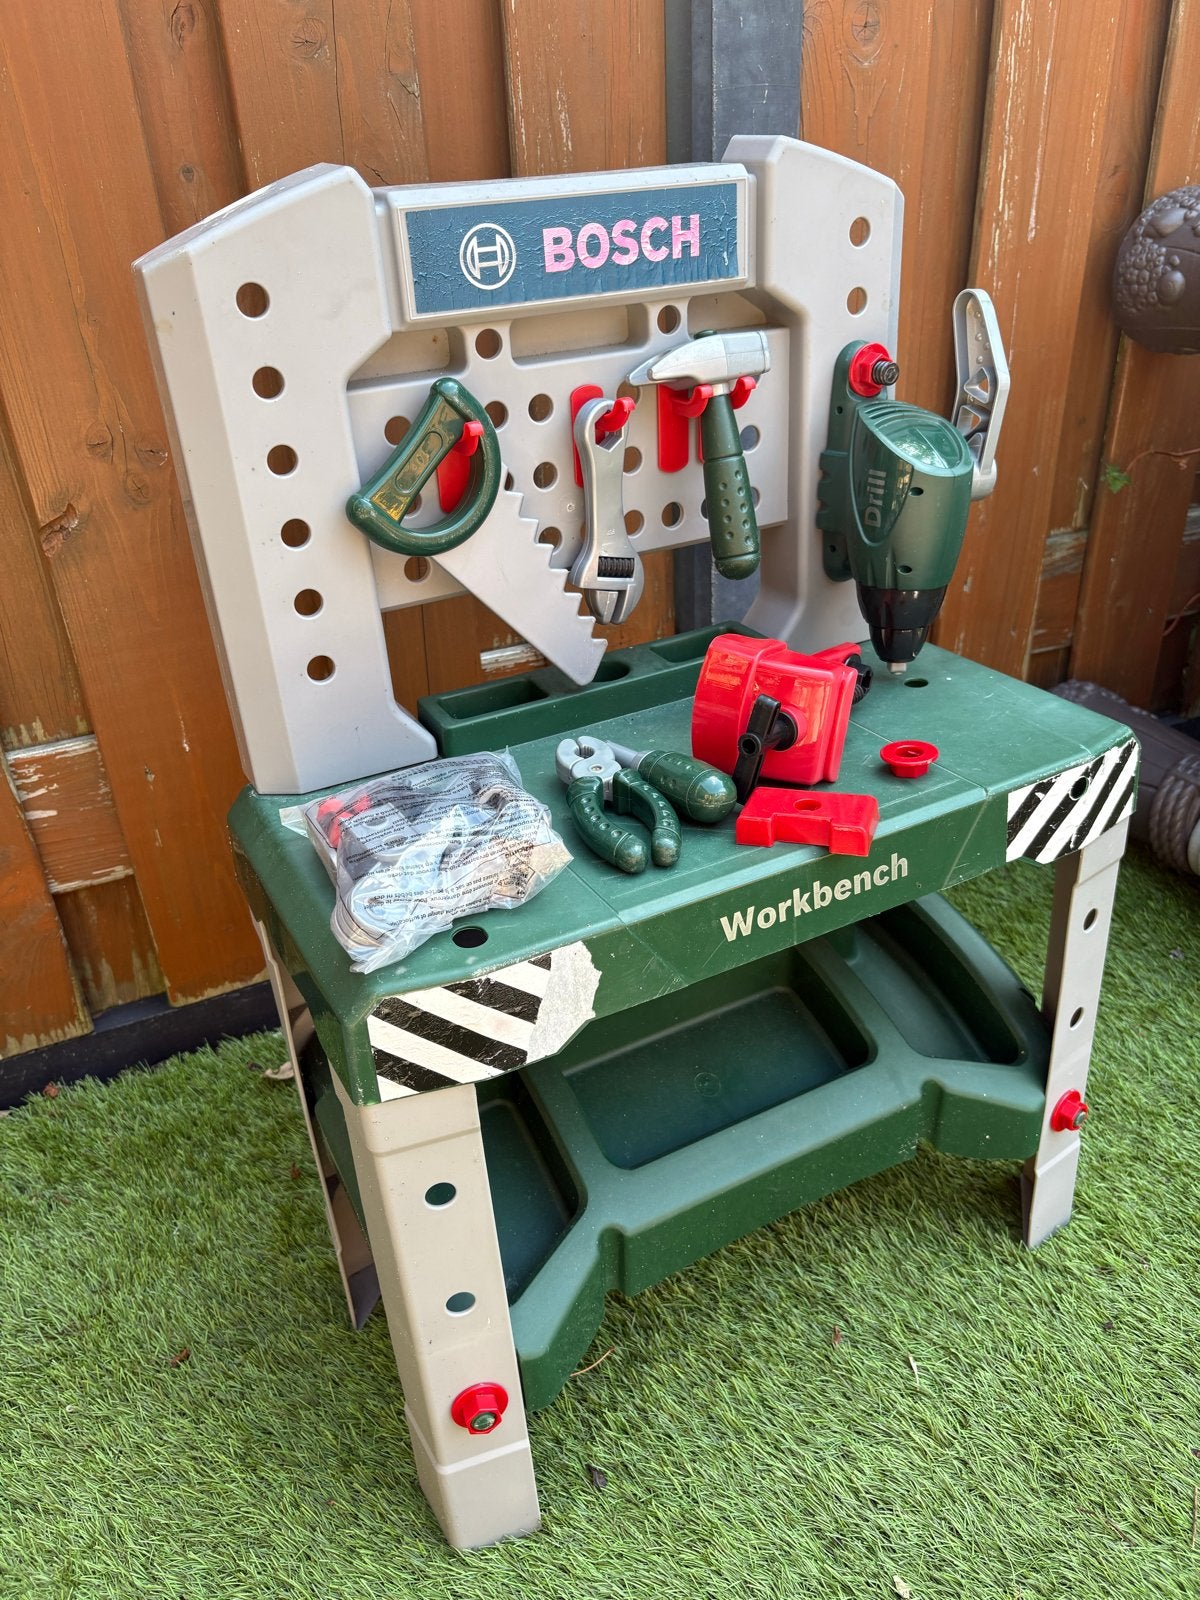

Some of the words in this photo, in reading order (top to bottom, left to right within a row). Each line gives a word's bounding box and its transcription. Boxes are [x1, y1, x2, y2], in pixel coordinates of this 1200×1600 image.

[542, 214, 701, 273] BOSCH
[864, 469, 887, 528] Drill
[719, 852, 908, 943] Workbench
